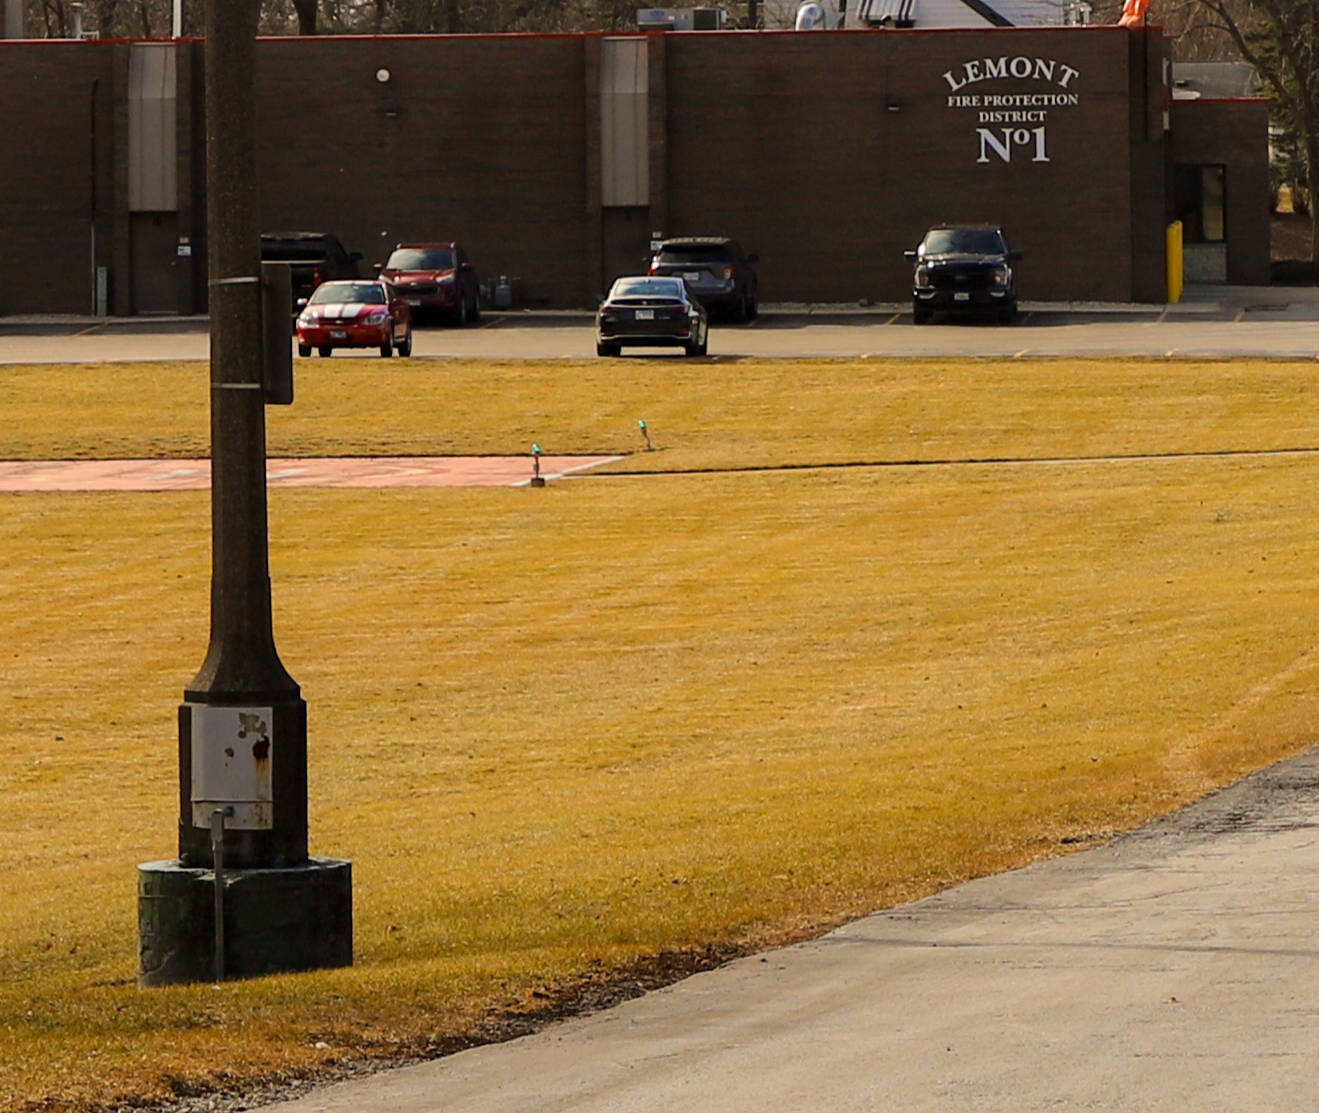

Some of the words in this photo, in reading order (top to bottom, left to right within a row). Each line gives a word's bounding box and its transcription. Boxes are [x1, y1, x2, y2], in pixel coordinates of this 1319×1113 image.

[942, 56, 1080, 92] LEMONT
[947, 95, 980, 107] FIRE
[983, 94, 1079, 107] PROTECTION
[979, 110, 1047, 123] DISTRICT
